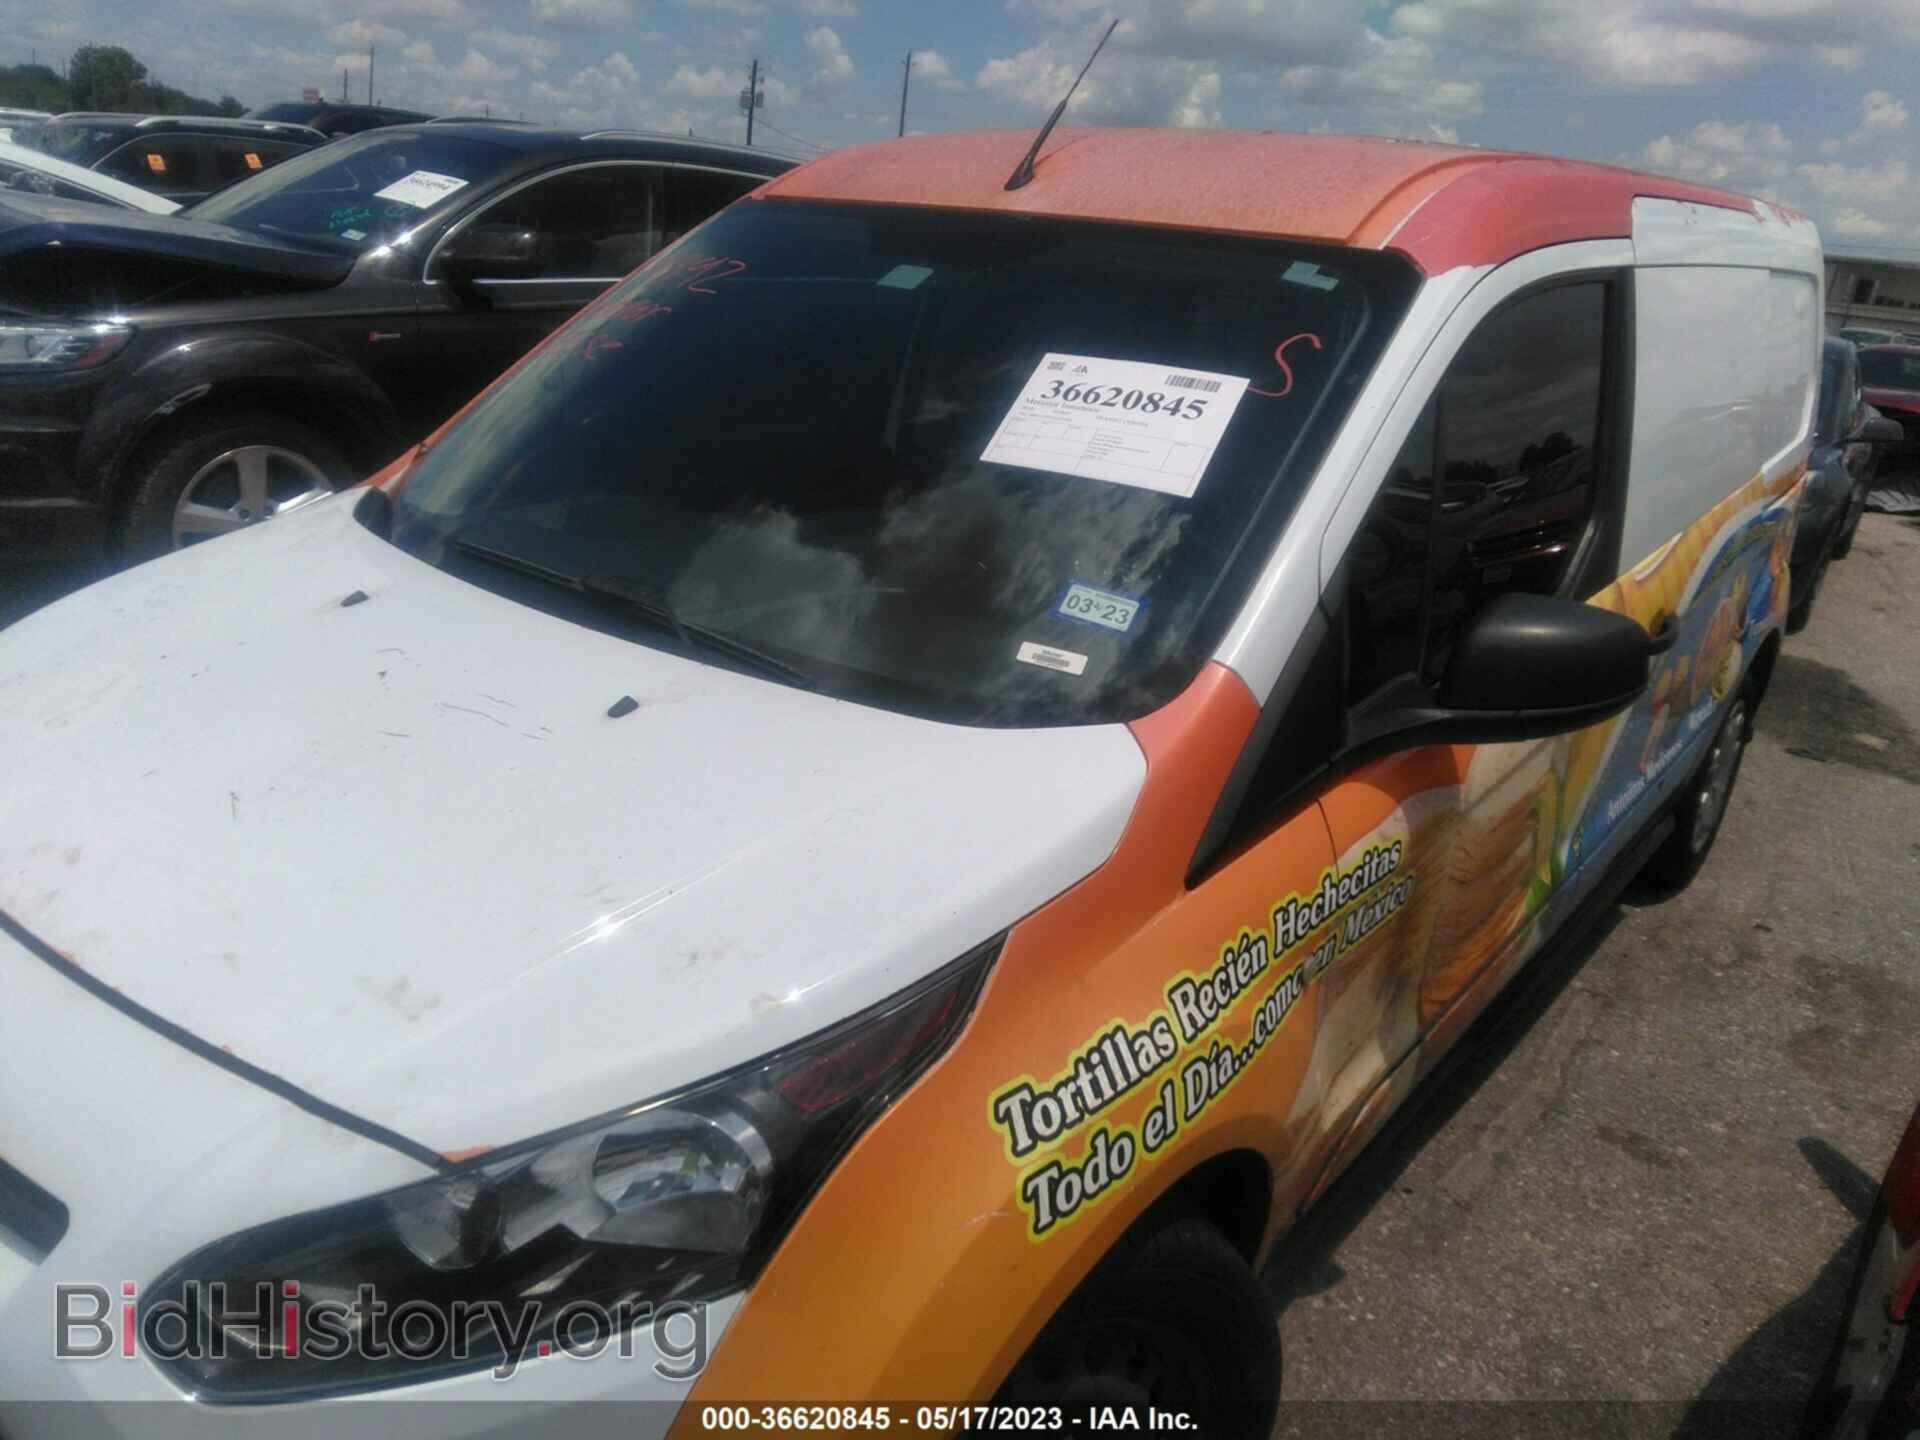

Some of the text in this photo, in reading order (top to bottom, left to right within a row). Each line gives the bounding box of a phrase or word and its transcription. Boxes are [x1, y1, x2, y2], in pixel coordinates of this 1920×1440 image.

[1041, 380, 1208, 420] 36620845
[1066, 594, 1094, 614] 03
[1101, 604, 1130, 625] 23
[997, 840, 1401, 1157] Tortillas Recién Hechecitas
[1024, 1127, 1134, 1234] Todo
[1143, 1078, 1177, 1154] el
